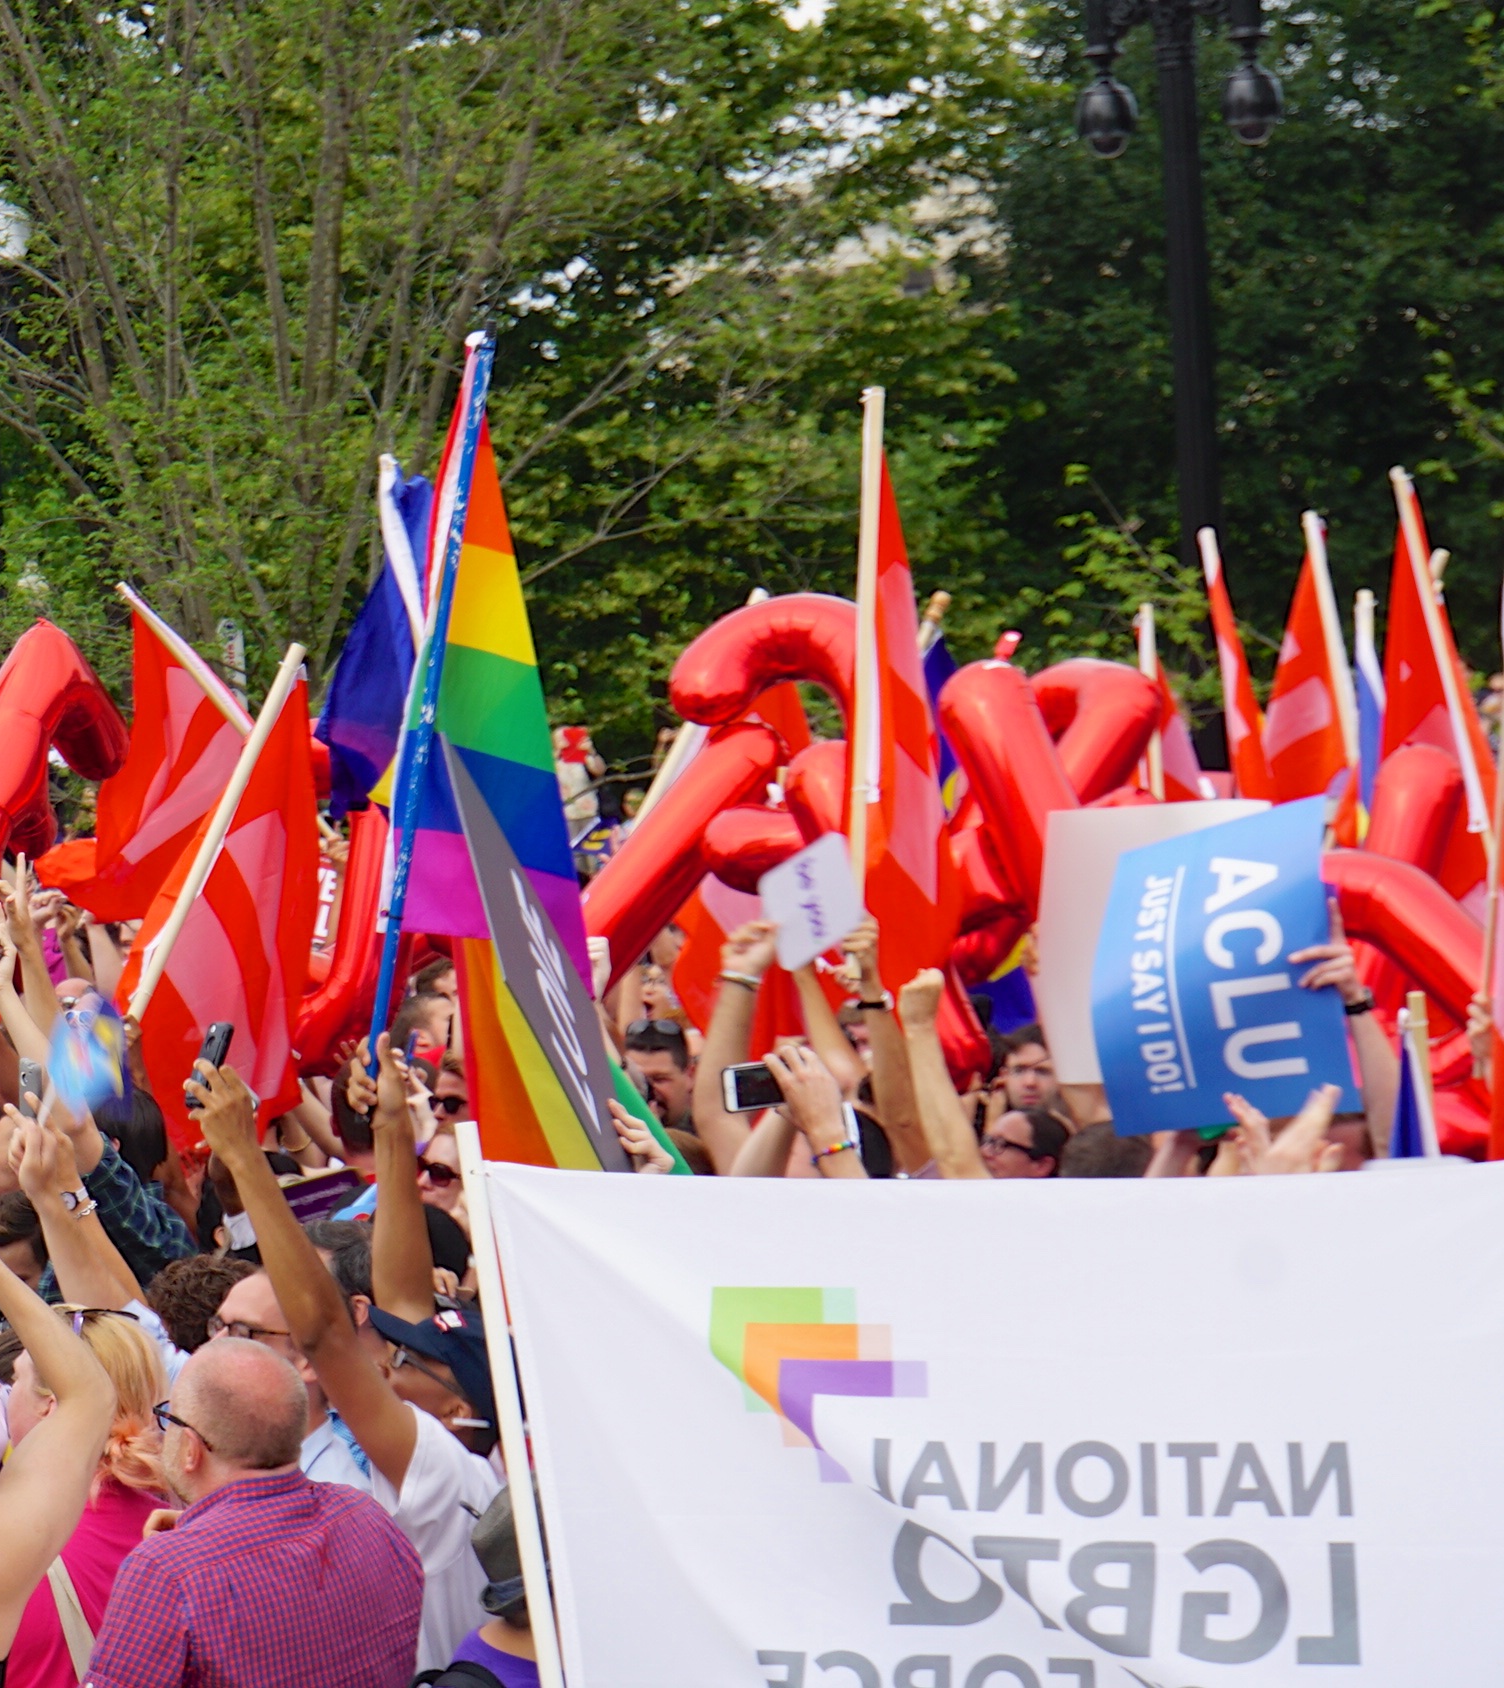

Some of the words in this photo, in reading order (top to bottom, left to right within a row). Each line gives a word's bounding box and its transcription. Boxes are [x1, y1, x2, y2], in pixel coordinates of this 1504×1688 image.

[1133, 875, 1175, 943] JUST
[1130, 949, 1169, 1014] SAY
[1203, 856, 1310, 1080] ACLU
[1136, 1021, 1173, 1036] I
[1141, 1040, 1186, 1095] DO!
